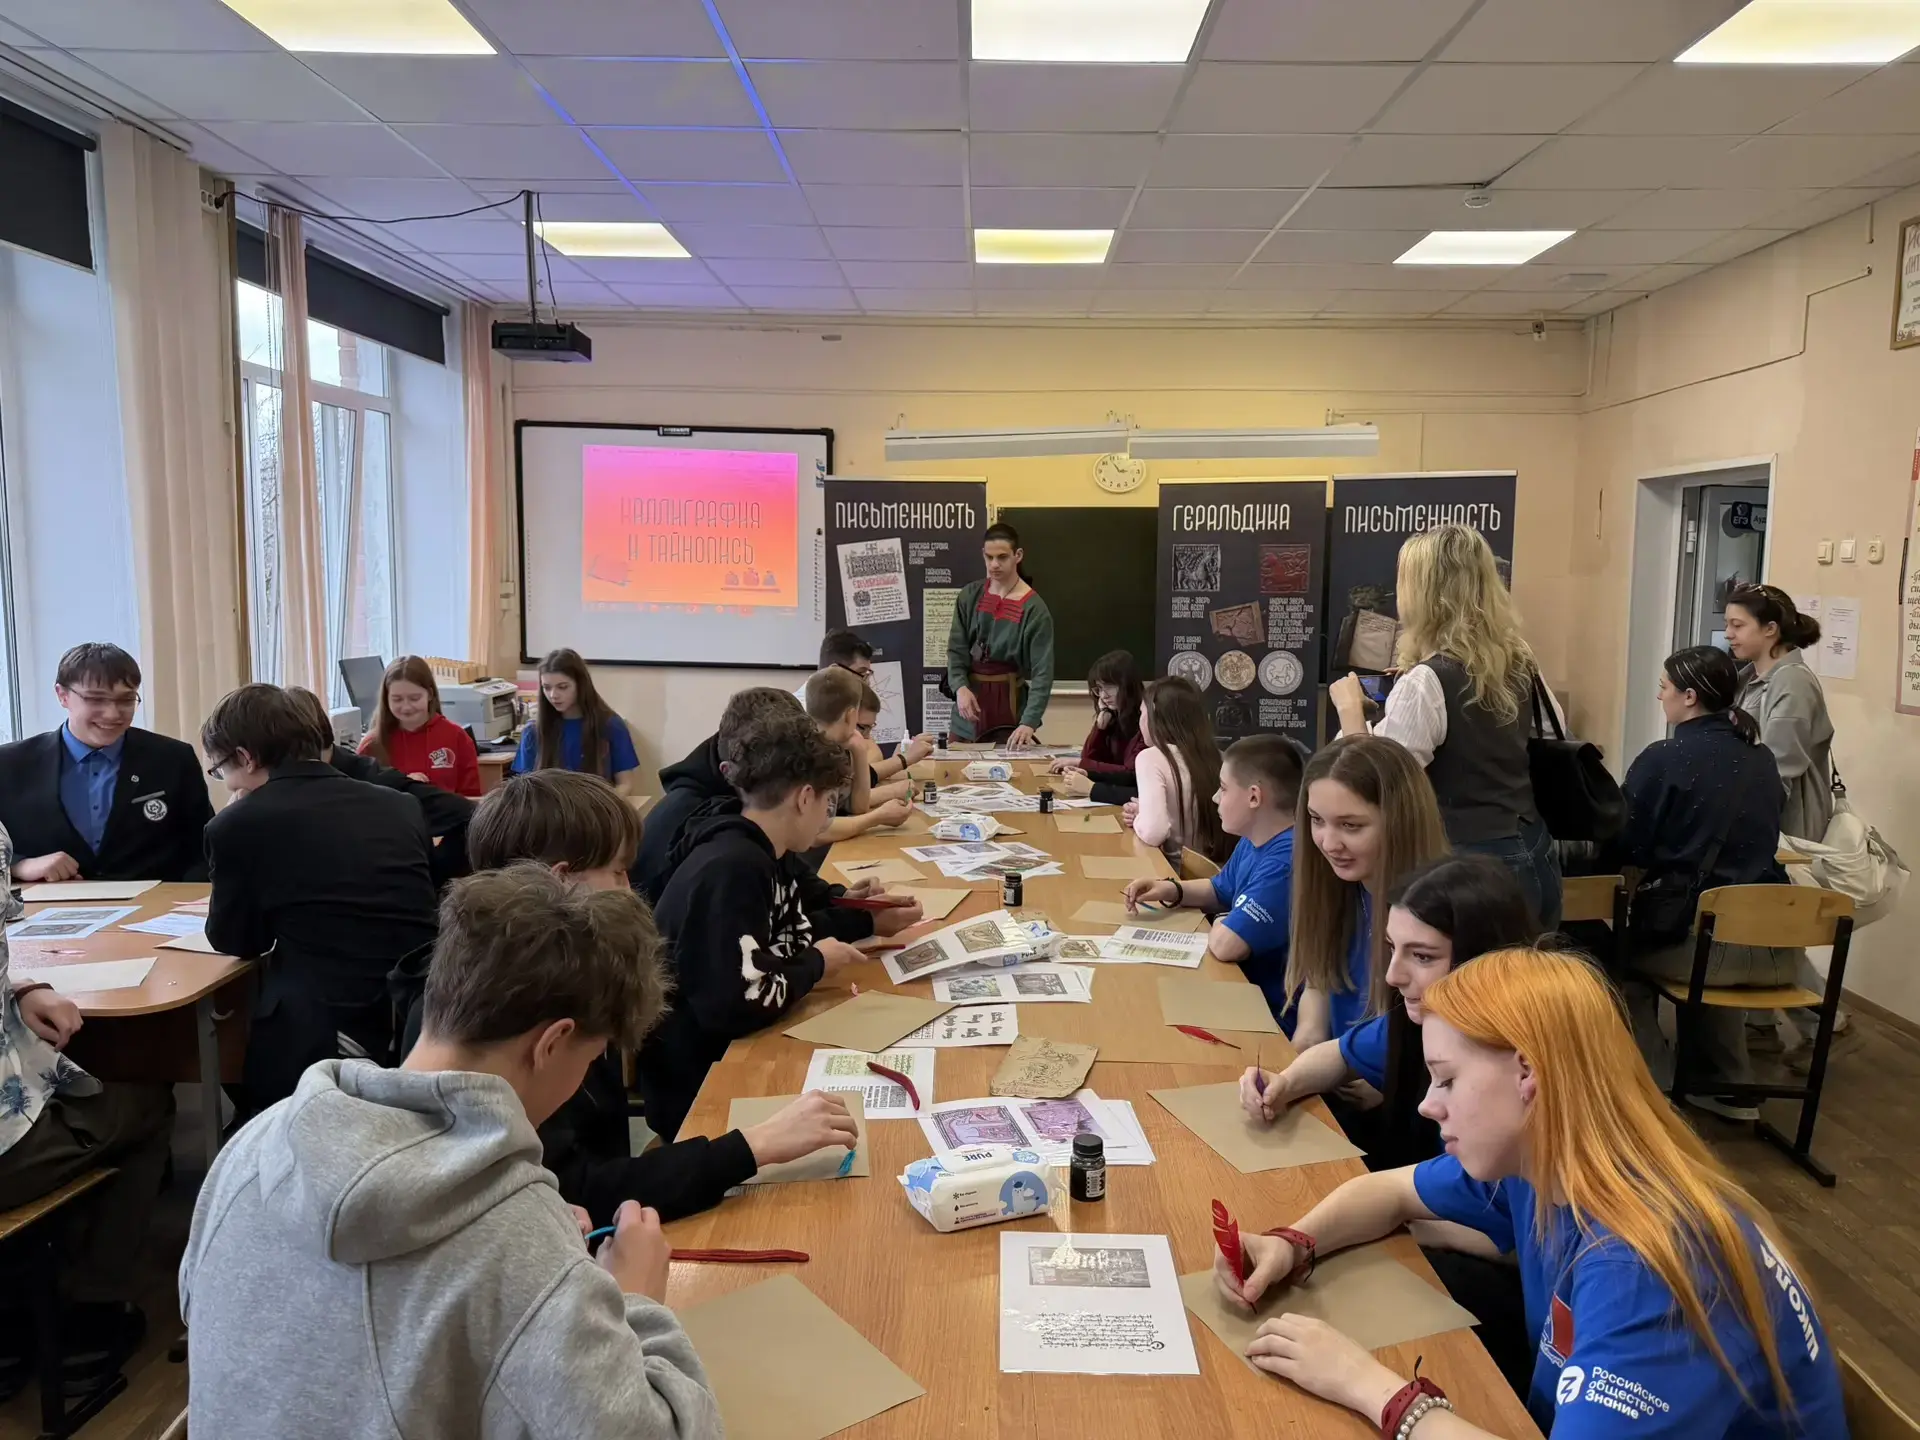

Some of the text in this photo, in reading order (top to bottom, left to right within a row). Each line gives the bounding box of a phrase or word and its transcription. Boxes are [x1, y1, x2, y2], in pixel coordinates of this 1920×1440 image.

[621, 497, 760, 529] КАЛЛИГРАФИЯ
[836, 502, 975, 529] ПИСЬМЕННОСТЬ
[1173, 504, 1290, 532] ГЕРАЛЬДИКА
[1344, 503, 1500, 533] ПИСЬМЕННОСТЬ
[1733, 516, 1748, 524] ЕГЭ
[628, 532, 754, 566] И ТАЙНОПИСЬ
[962, 1152, 992, 1162] PURE
[1760, 1243, 1820, 1362] ШКОЛА
[1585, 1389, 1639, 1420] Знание
[1589, 1379, 1654, 1416] общество
[1592, 1366, 1670, 1412] Российское
